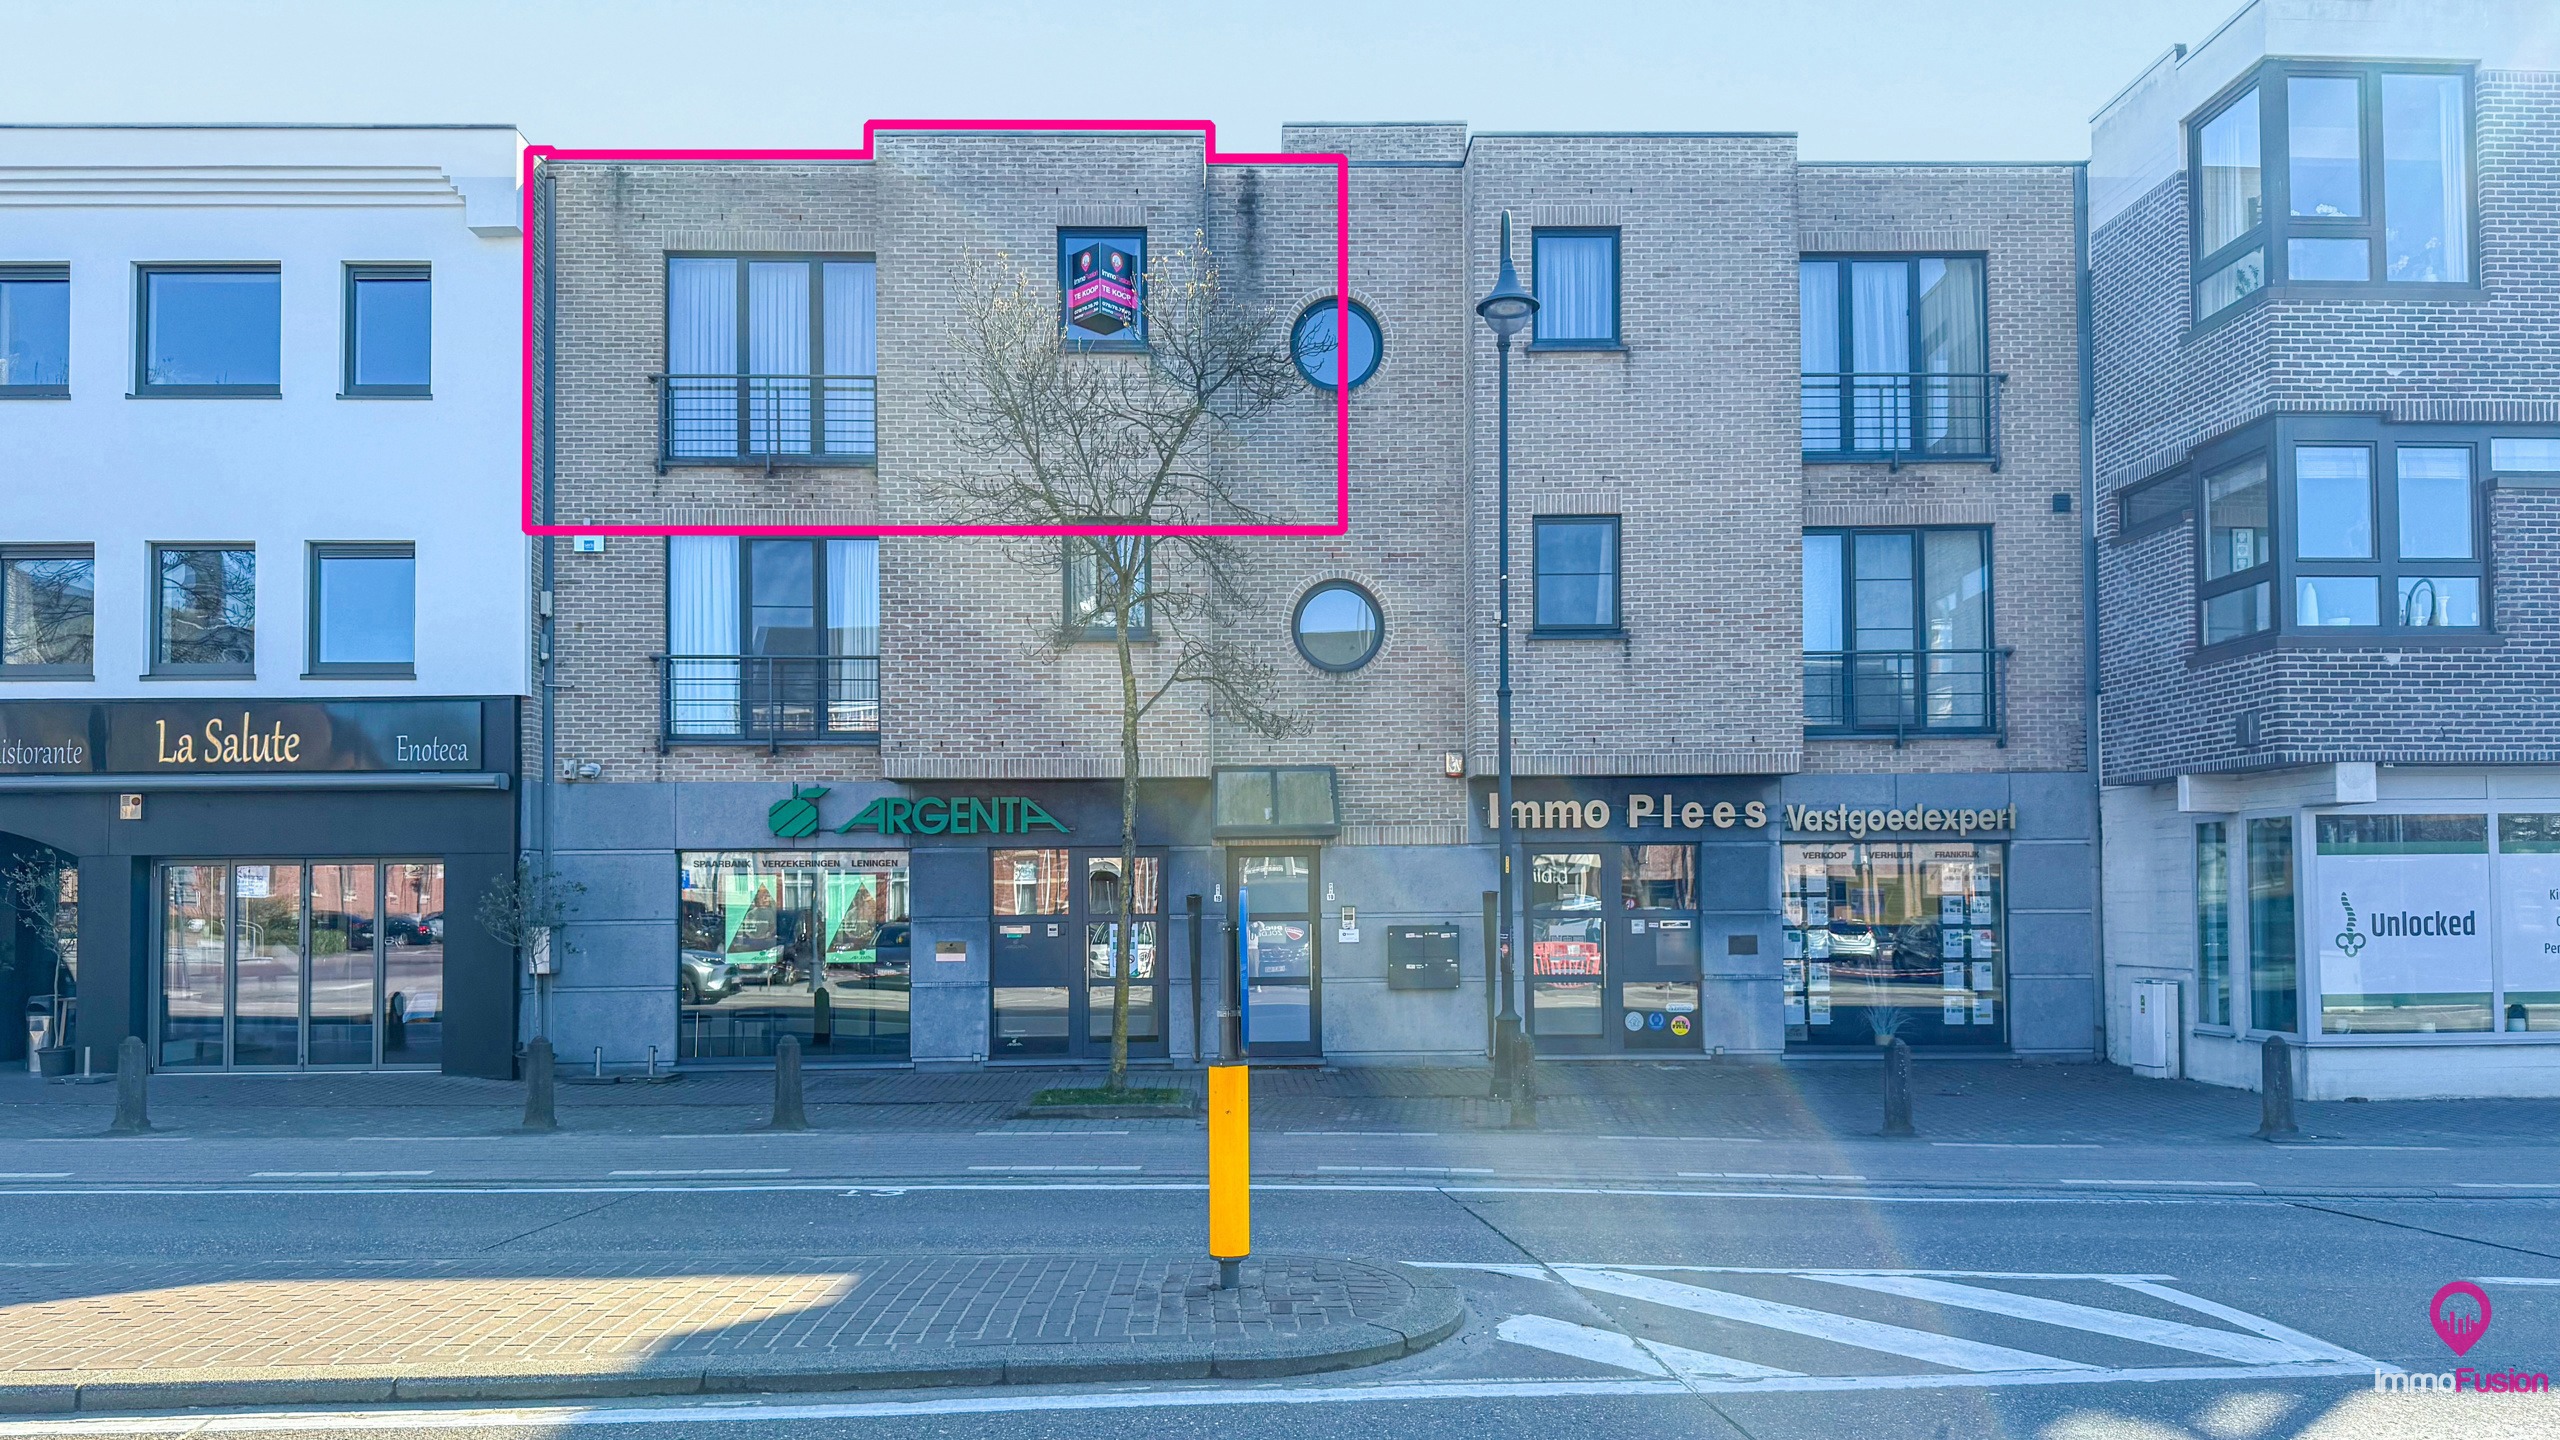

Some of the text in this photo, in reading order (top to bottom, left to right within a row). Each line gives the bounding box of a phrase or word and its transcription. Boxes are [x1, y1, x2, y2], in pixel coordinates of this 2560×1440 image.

[1074, 285, 1099, 300] TE KOOP
[1101, 284, 1110, 294] TE
[156, 711, 300, 764] La Salute
[396, 735, 469, 762] Enoteca
[0, 739, 83, 765] istorante
[836, 796, 1071, 834] ARGENTA
[1488, 792, 1767, 829] Immo Plees
[1786, 803, 2016, 838] Vastgoedexpert
[693, 859, 899, 868] SPAARBANK VERZEKERINGEN LENINGEN
[1802, 850, 1980, 859] VERKOOP VERHUUR FRANKRIJK
[2549, 889, 2560, 900] Ki
[2371, 910, 2476, 937] Unlocked
